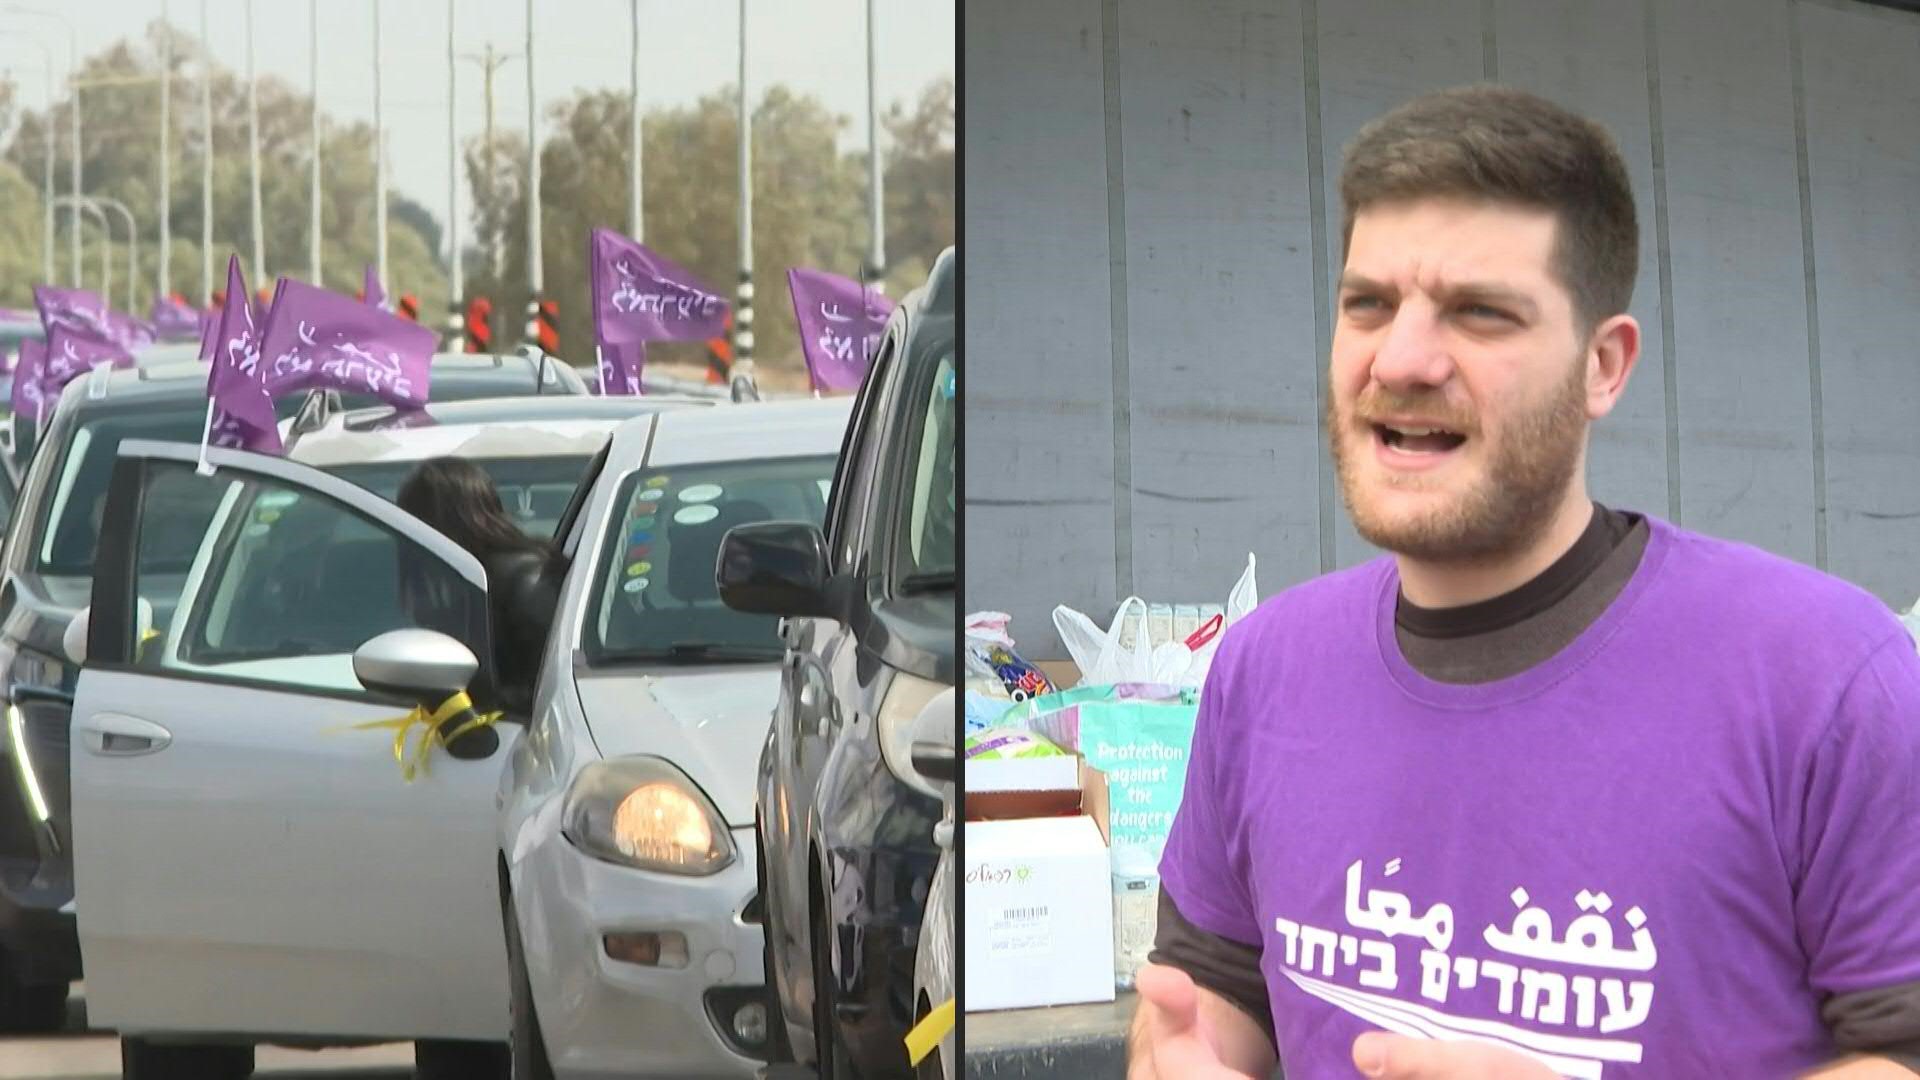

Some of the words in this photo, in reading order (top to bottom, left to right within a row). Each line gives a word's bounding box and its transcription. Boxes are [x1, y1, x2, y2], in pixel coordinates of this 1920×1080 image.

[1096, 741, 1184, 761] Protection
[1127, 786, 1153, 805] the
[1345, 857, 1454, 953] معًا
[1483, 886, 1657, 971] نقف
[1275, 917, 1398, 990] ביחד
[1421, 949, 1654, 1033] עומדים
